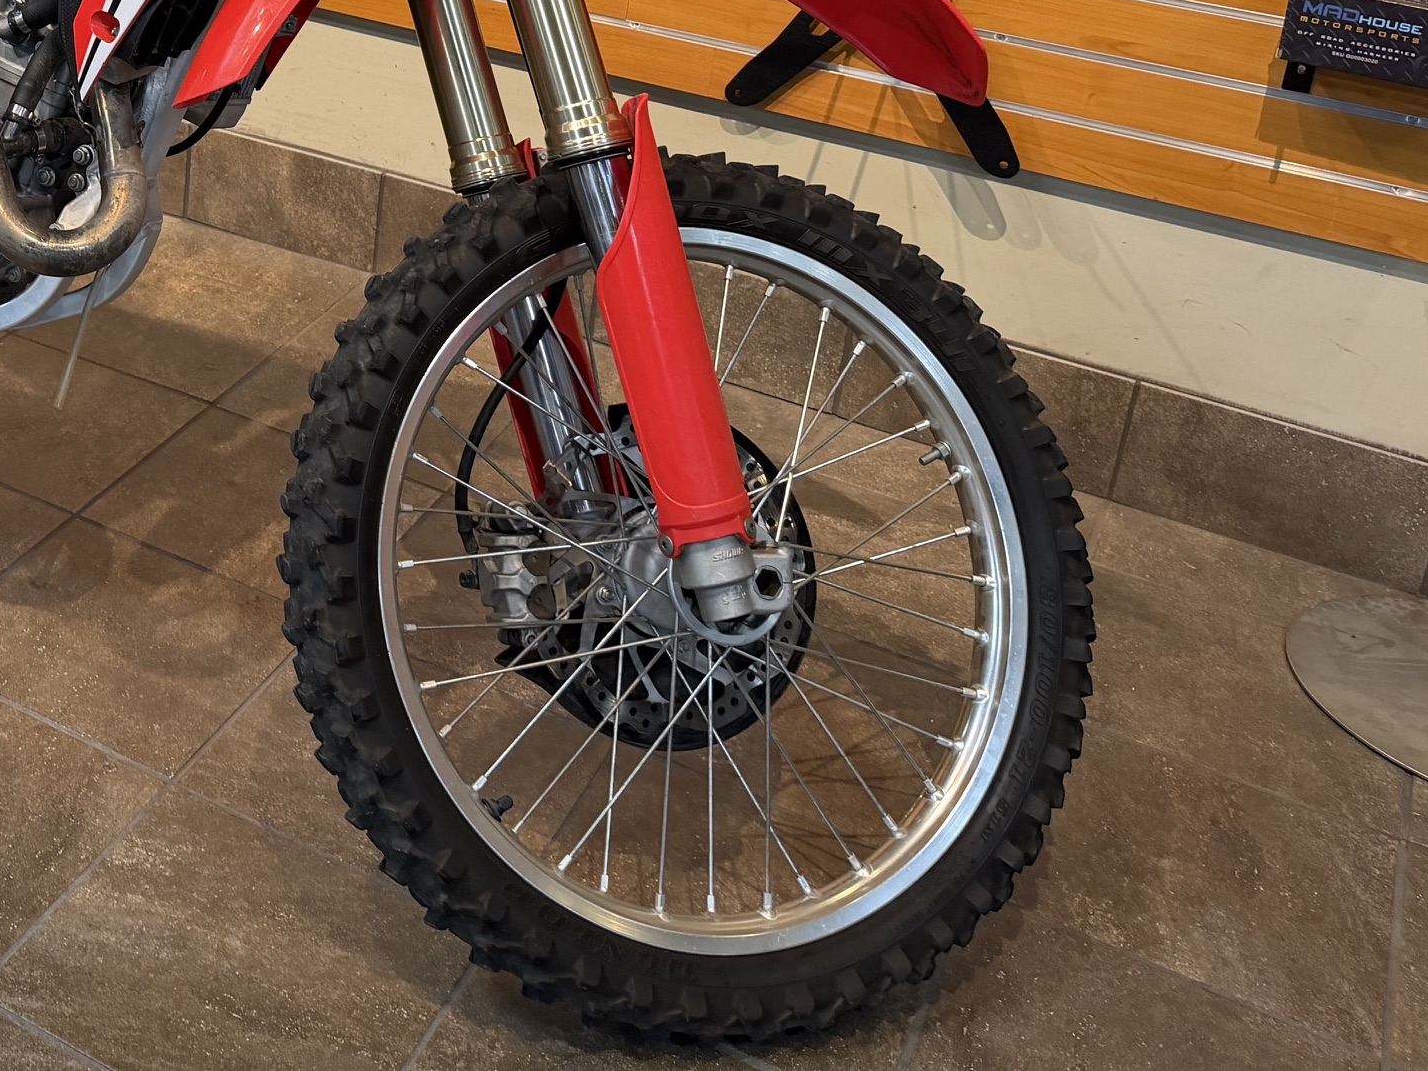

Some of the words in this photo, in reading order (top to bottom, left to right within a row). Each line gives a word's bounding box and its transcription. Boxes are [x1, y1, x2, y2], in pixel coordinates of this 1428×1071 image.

[1299, 15, 1421, 45] MOTORSPORTS
[1302, 0, 1424, 36] MADHOUSE
[1297, 29, 1314, 38] OFF
[1320, 34, 1344, 43] ROAD
[1350, 41, 1417, 58] ACCESSORIES
[1315, 41, 1351, 52] WIRING
[1357, 49, 1400, 61] HARNESS
[1331, 50, 1345, 58] SKU
